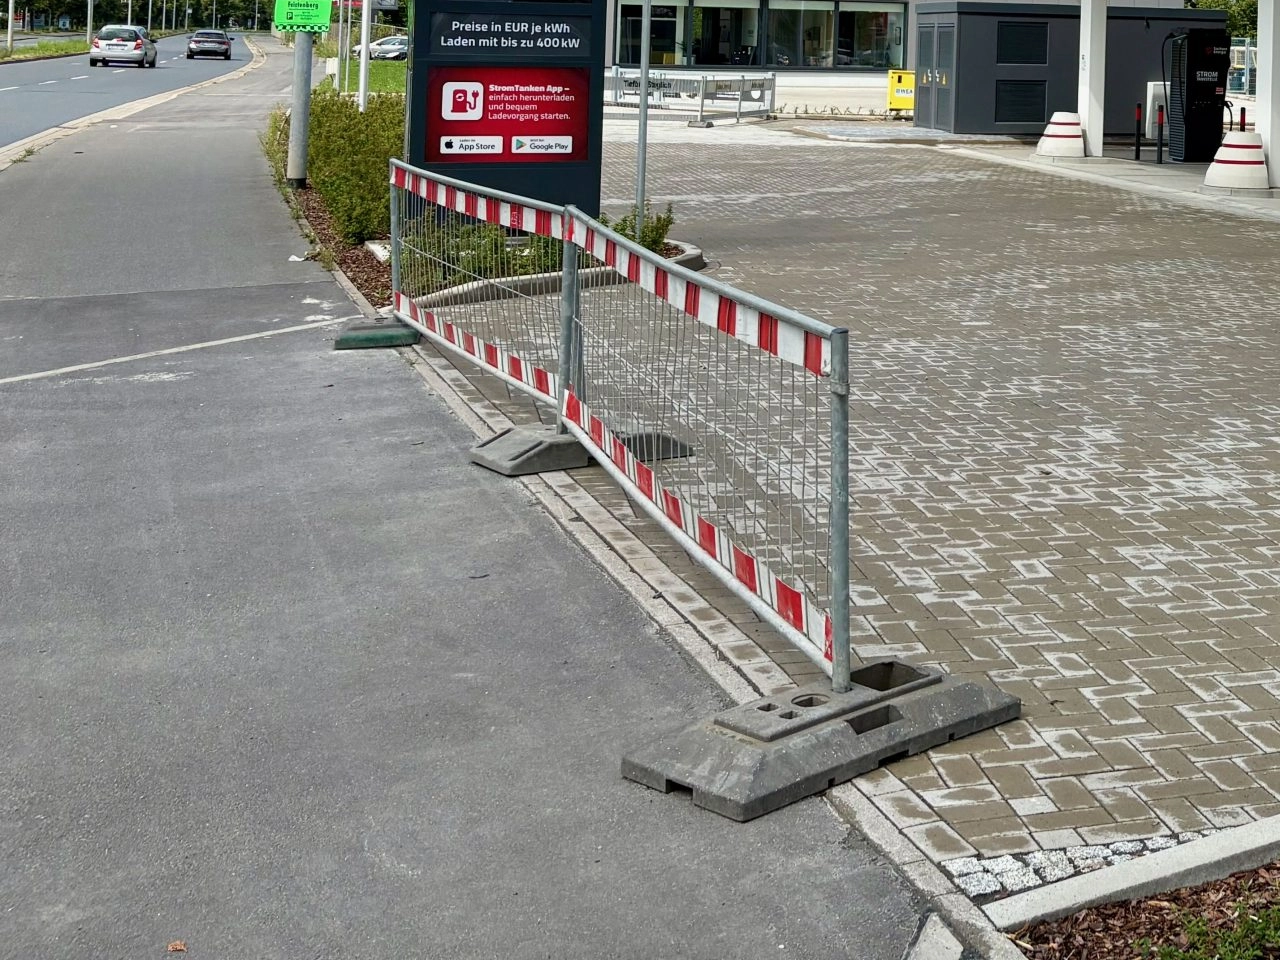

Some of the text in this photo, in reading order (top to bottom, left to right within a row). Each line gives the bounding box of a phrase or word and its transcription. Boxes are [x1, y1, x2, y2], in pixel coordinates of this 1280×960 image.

[452, 21, 570, 35] Preise in EUR je kWh
[440, 36, 580, 48] Laden mit bis zu 400 kW
[489, 84, 545, 92] StromTanken
[546, 85, 563, 94] App
[520, 94, 575, 102] herunterladen
[488, 103, 537, 112] und bequem
[488, 113, 539, 121] Ladevorgang
[459, 143, 474, 151] App
[529, 143, 569, 151] Google Play
